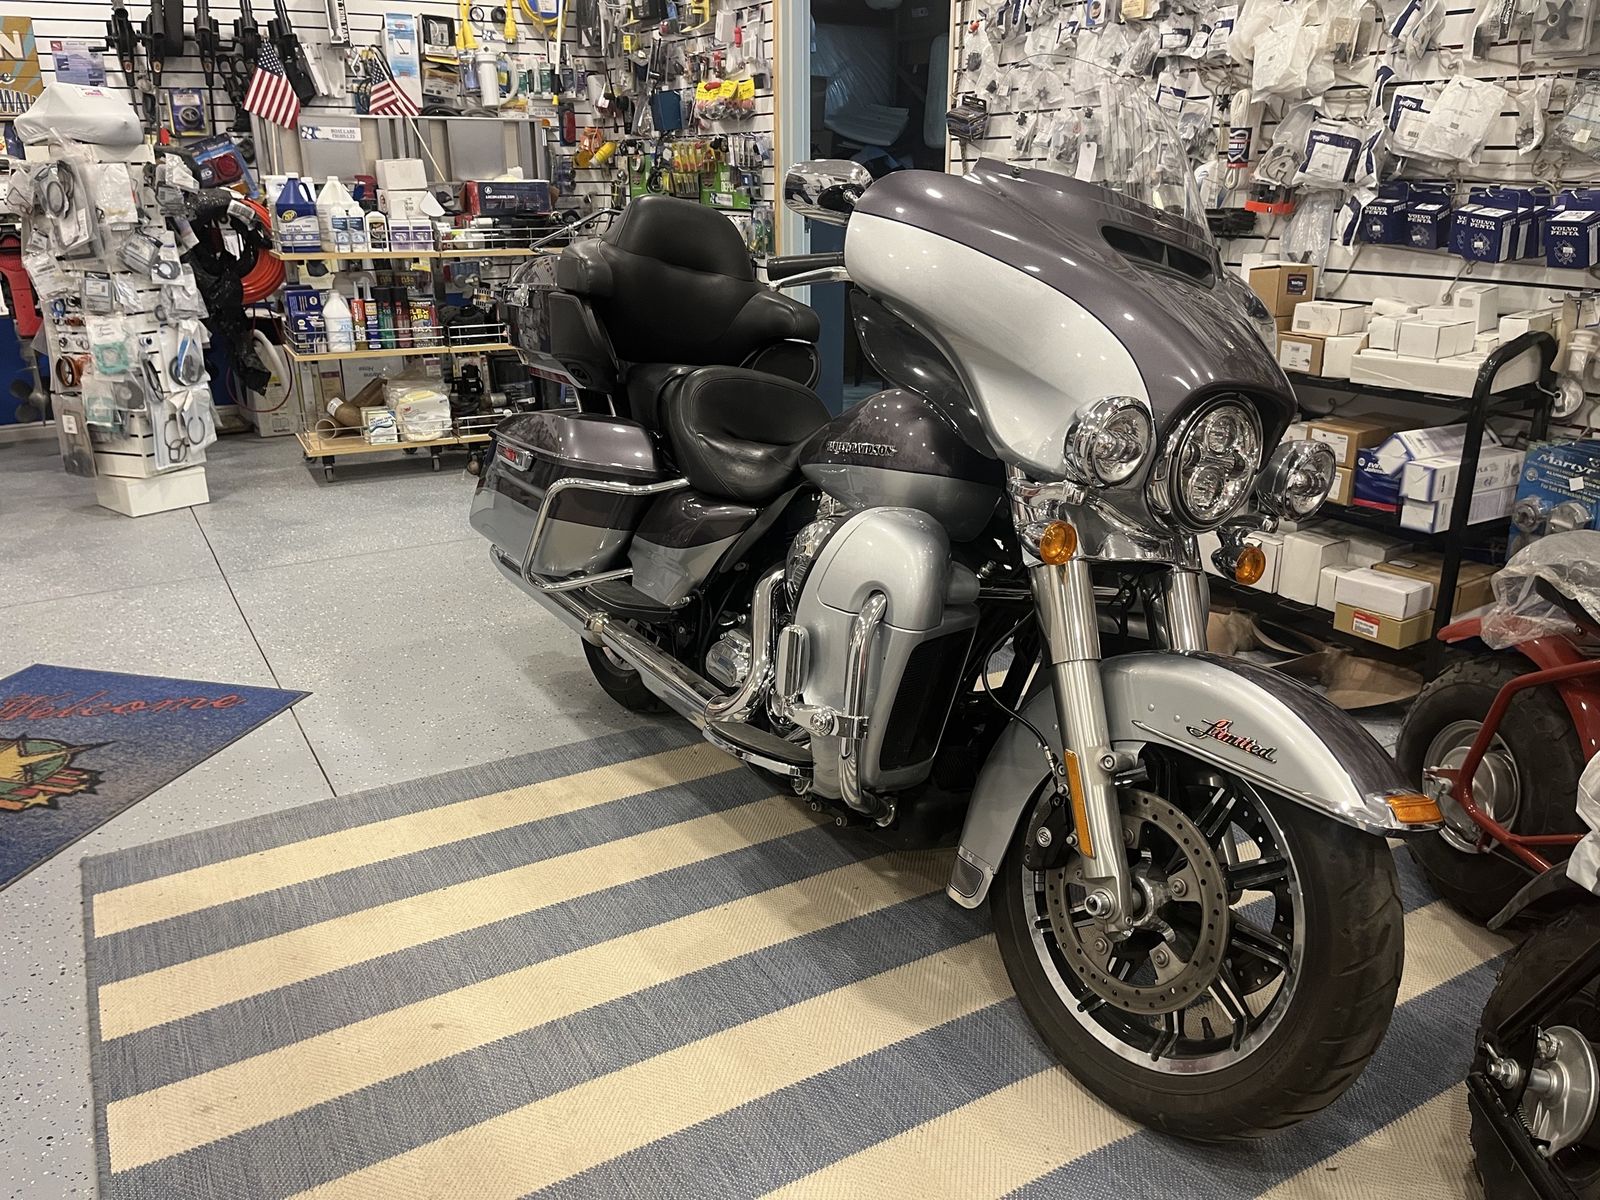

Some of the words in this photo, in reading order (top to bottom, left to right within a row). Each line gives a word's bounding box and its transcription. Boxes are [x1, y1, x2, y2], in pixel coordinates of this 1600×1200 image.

[1470, 222, 1496, 231] PENTA
[1471, 218, 1495, 226] VOLVO
[1537, 453, 1597, 474] Martyr
[0, 689, 246, 720] Welcome
[1186, 719, 1278, 764] Limited
